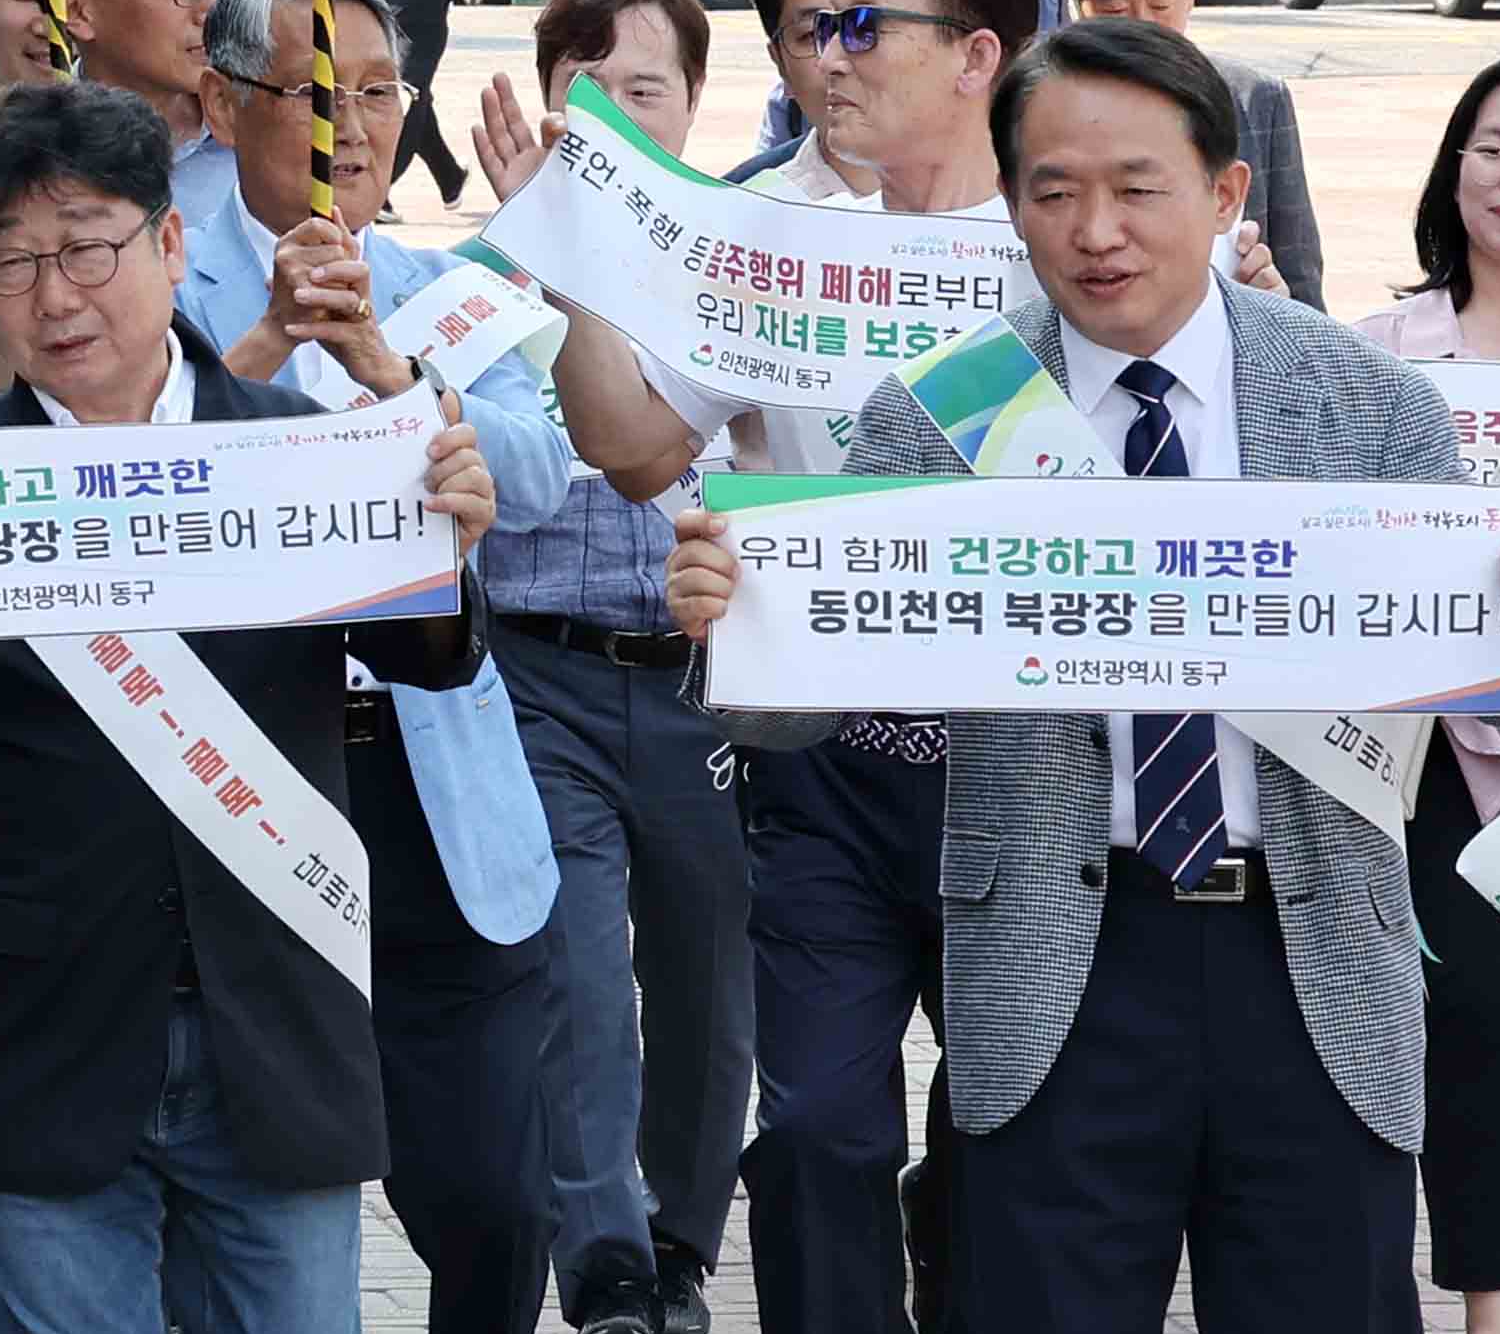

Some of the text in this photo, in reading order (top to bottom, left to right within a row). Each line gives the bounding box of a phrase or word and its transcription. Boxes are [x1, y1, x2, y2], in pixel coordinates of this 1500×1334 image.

[819, 261, 1004, 315] 폐해로부터
[696, 291, 746, 339] 우리
[753, 300, 850, 359] 자녀를
[716, 349, 834, 393] 인천광역시 동구
[72, 455, 215, 501] 깨끗한
[128, 505, 261, 559] 만들어
[274, 495, 427, 550] 갑시다!
[737, 534, 1300, 582] 우리 함께 건강하고 깨끗한
[109, 577, 158, 609] 동구
[806, 589, 987, 638] 동인천역
[1205, 593, 1337, 639] 만들어
[1052, 656, 1230, 689] 인천광역시 동구
